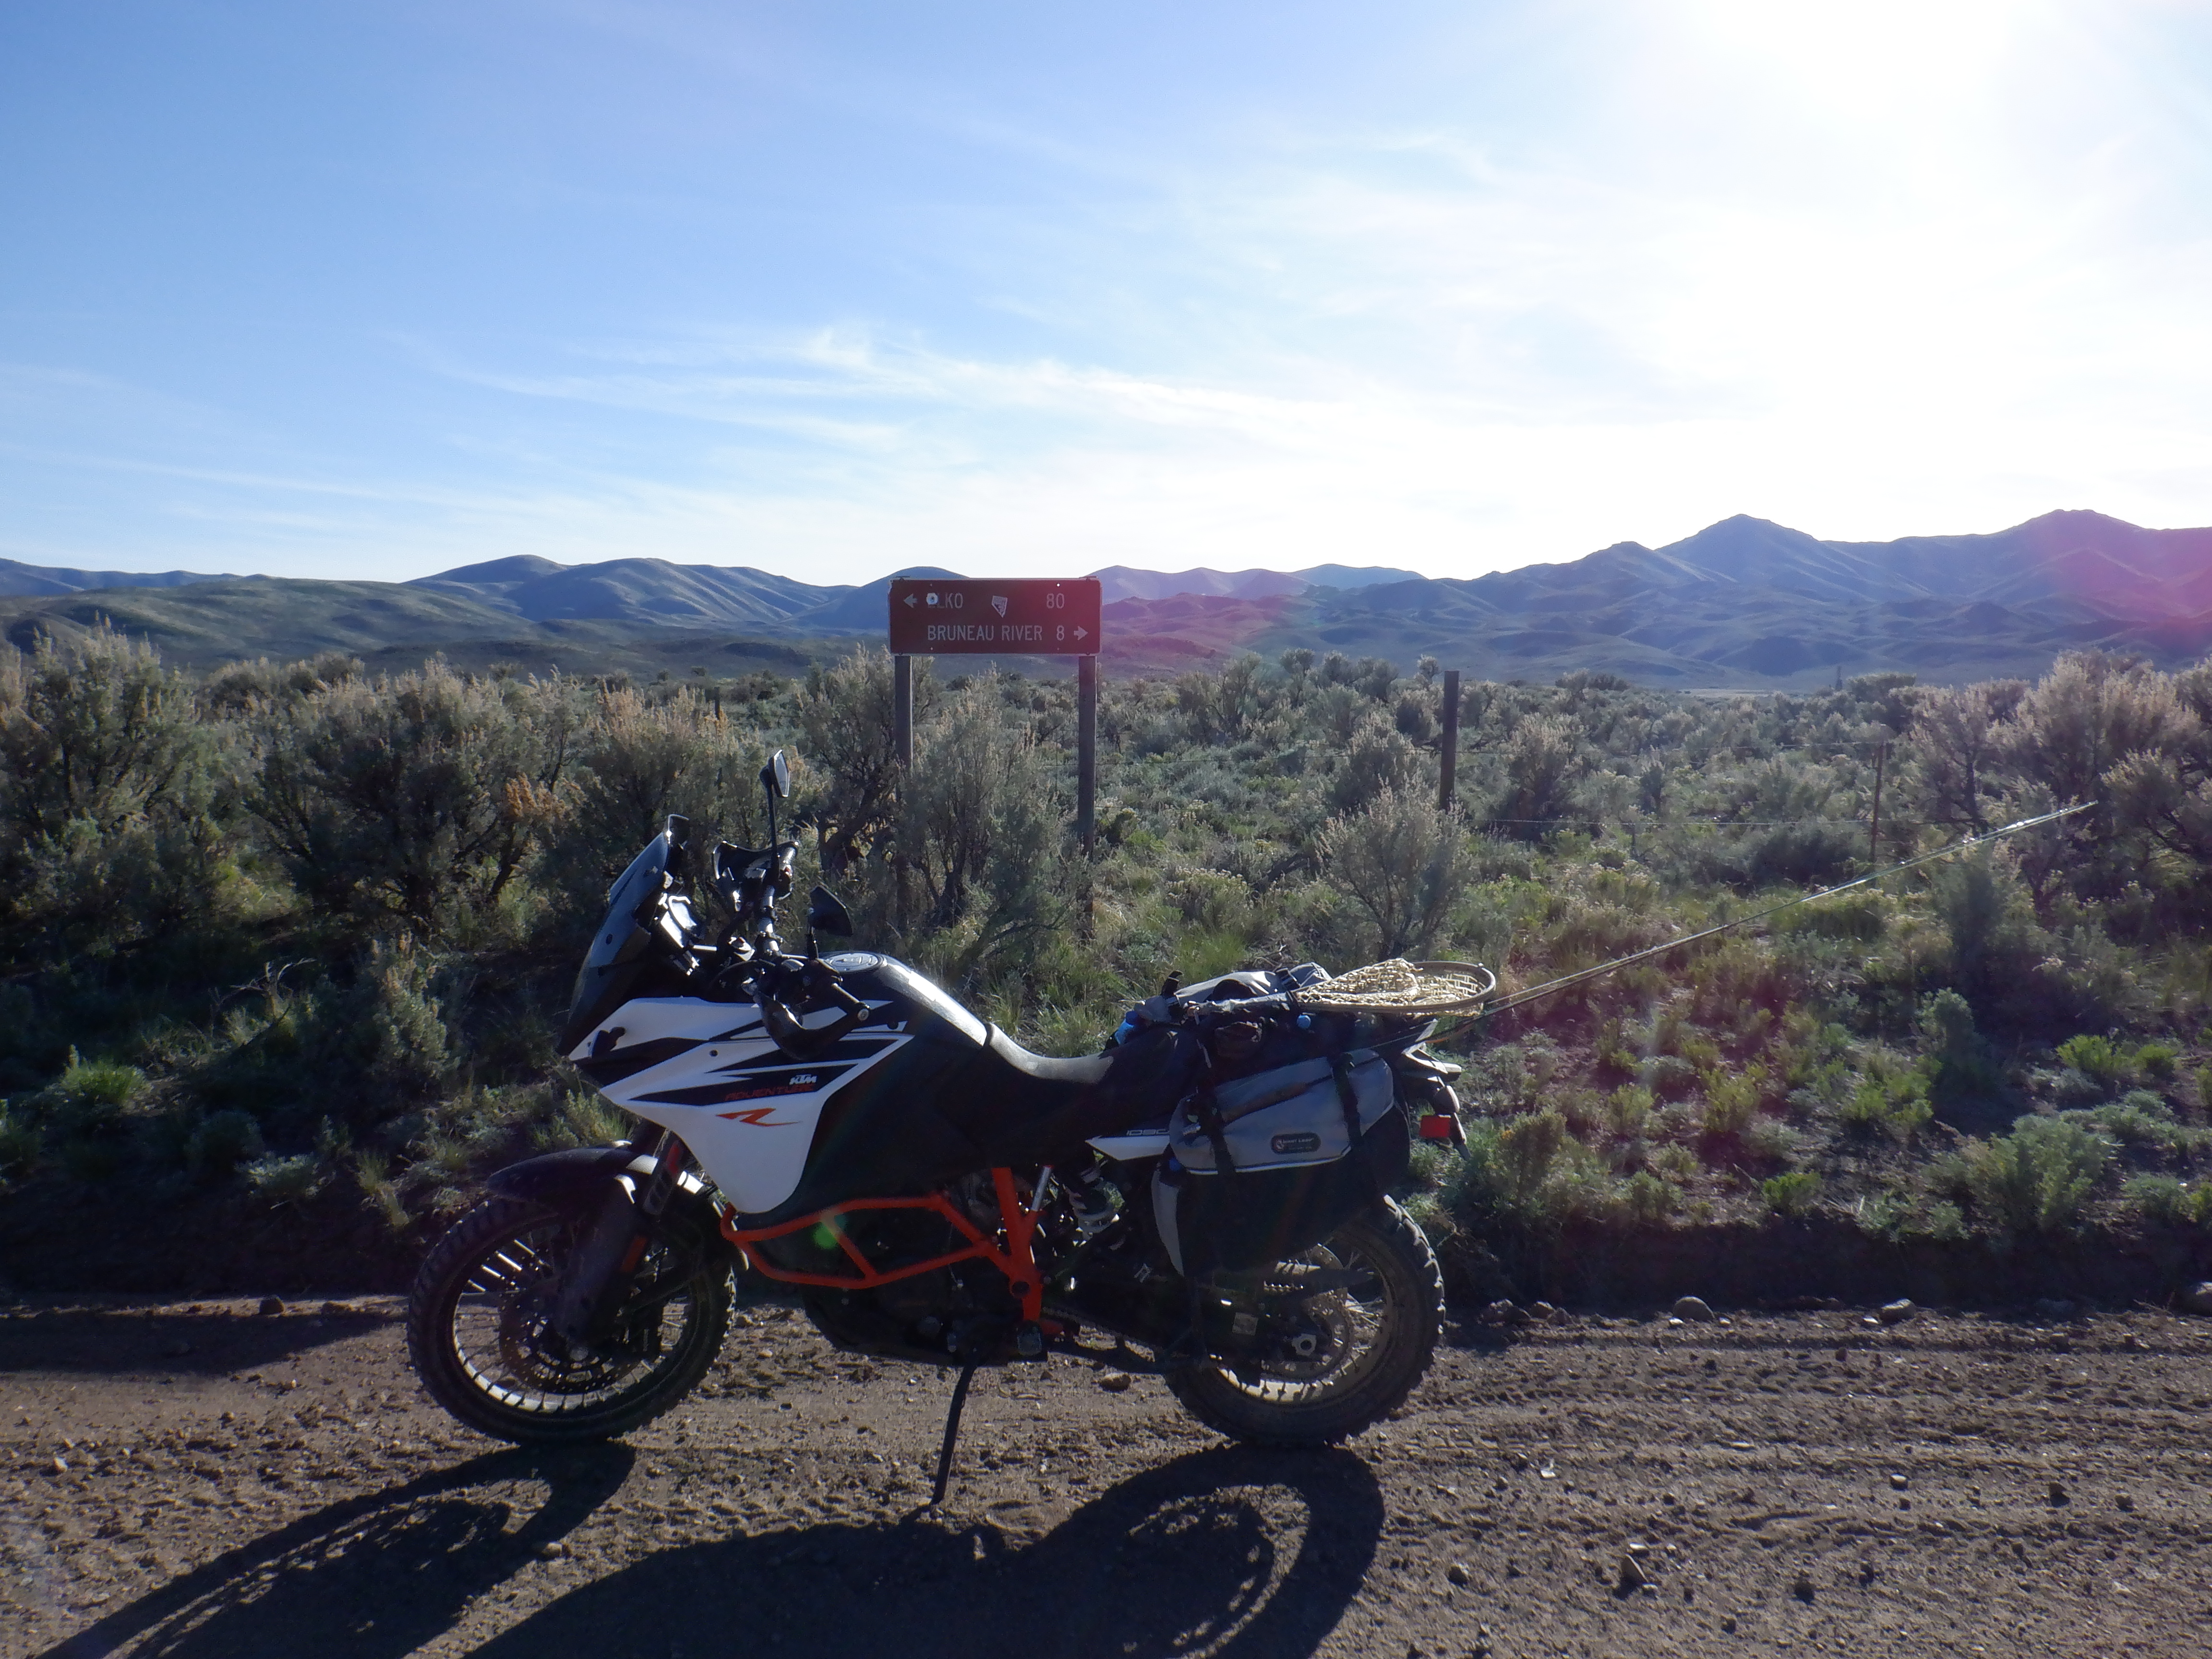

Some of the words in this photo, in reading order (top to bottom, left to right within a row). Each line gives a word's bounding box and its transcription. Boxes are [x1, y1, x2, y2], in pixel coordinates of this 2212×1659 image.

[927, 592, 963, 609] LKO
[1046, 593, 1065, 609] 80
[927, 625, 994, 641] BRUNEAU
[1001, 625, 1043, 641] RIVER
[1056, 625, 1065, 641] 8
[789, 1074, 817, 1085] KTM
